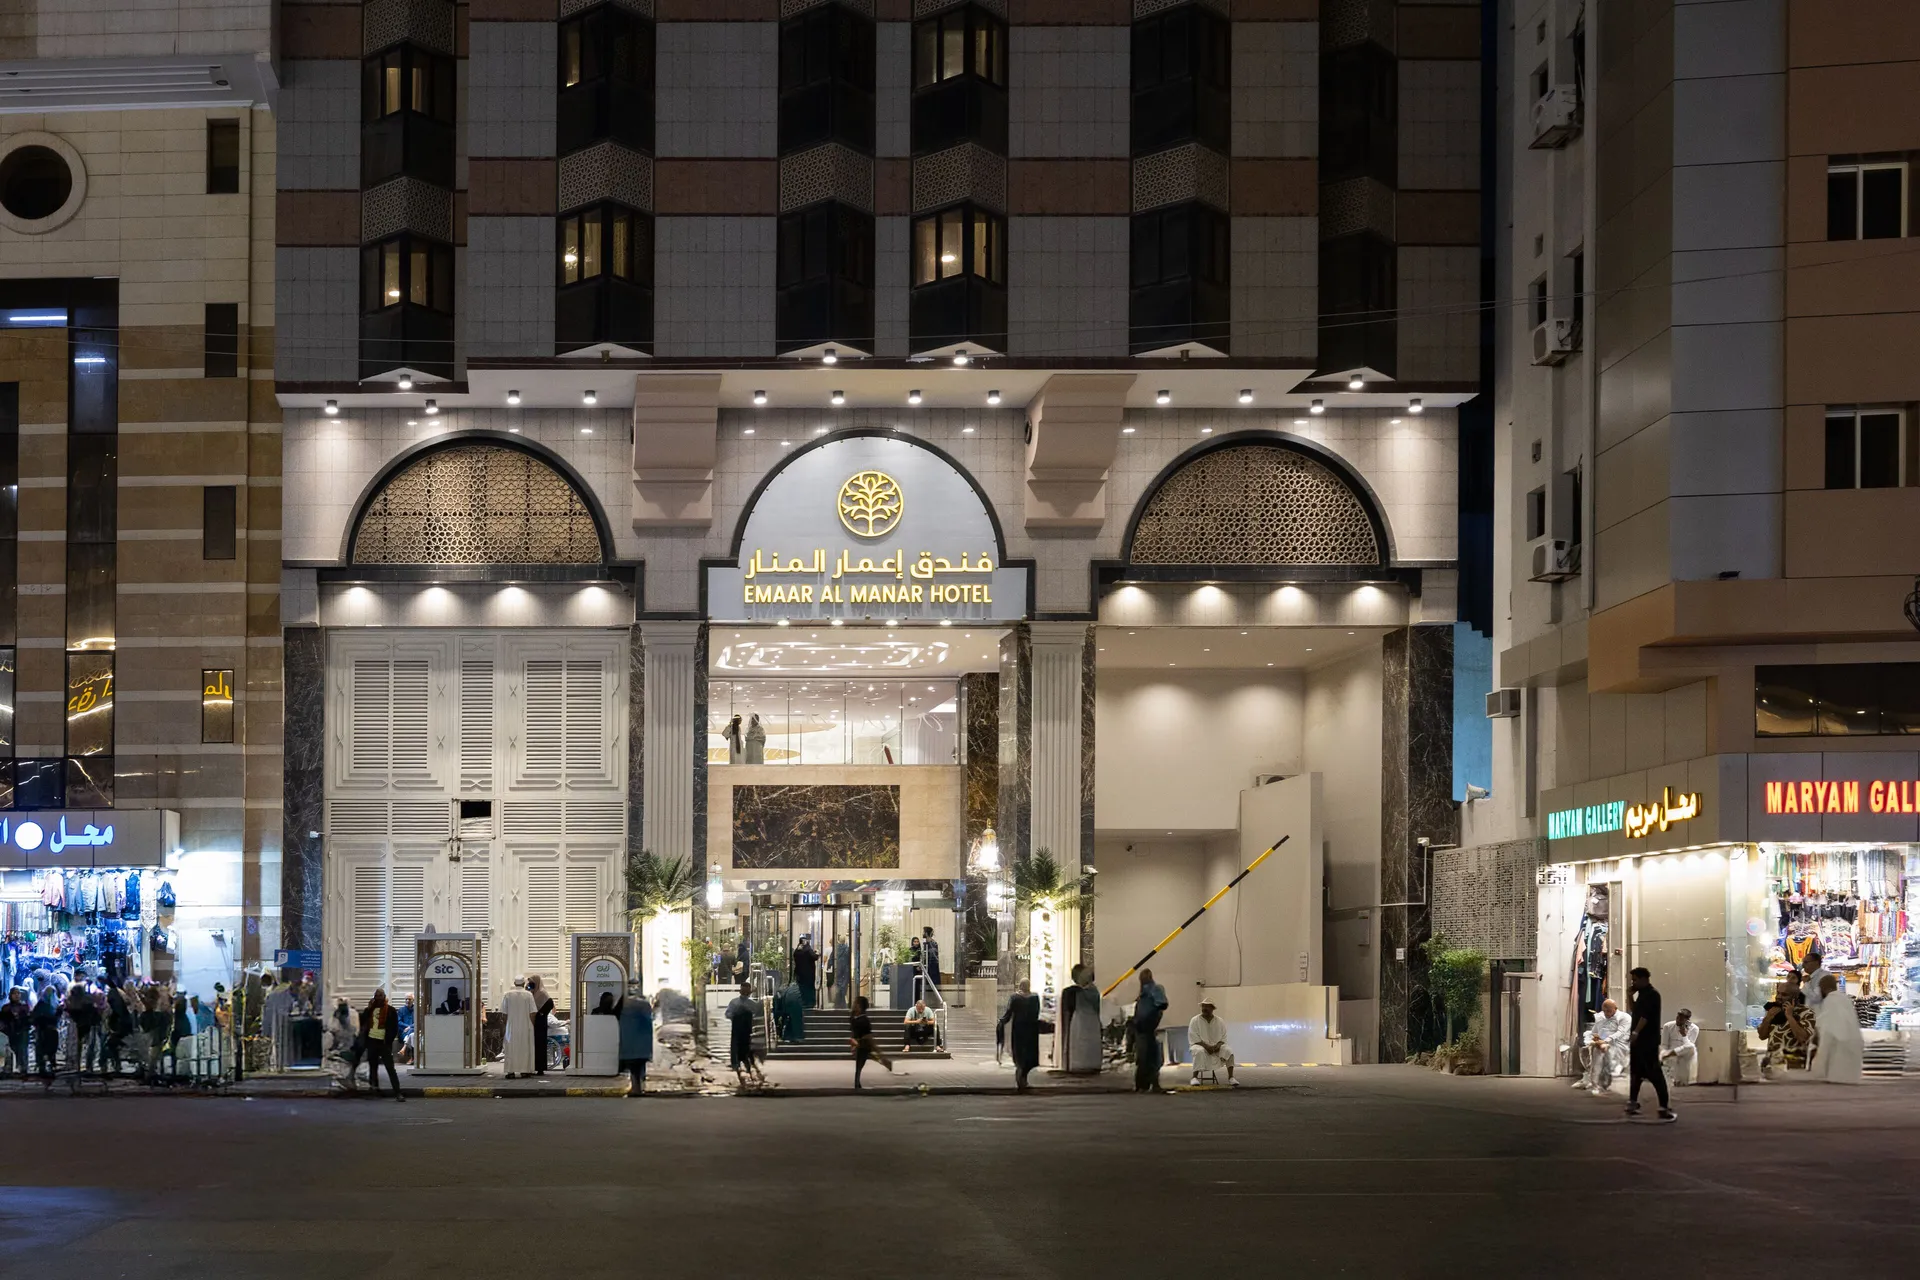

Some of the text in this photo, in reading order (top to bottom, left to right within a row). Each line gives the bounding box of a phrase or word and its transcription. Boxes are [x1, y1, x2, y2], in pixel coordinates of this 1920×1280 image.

[744, 549, 993, 580] فندق إعمار المنار
[744, 584, 993, 603] EMAAR AL MANAR HOTEL
[1625, 786, 1702, 839] محل مريم
[1765, 780, 1860, 814] MARYAM
[49, 814, 114, 854] محل
[1548, 800, 1625, 840] MARYAM GALLERY
[434, 964, 454, 974] stc
